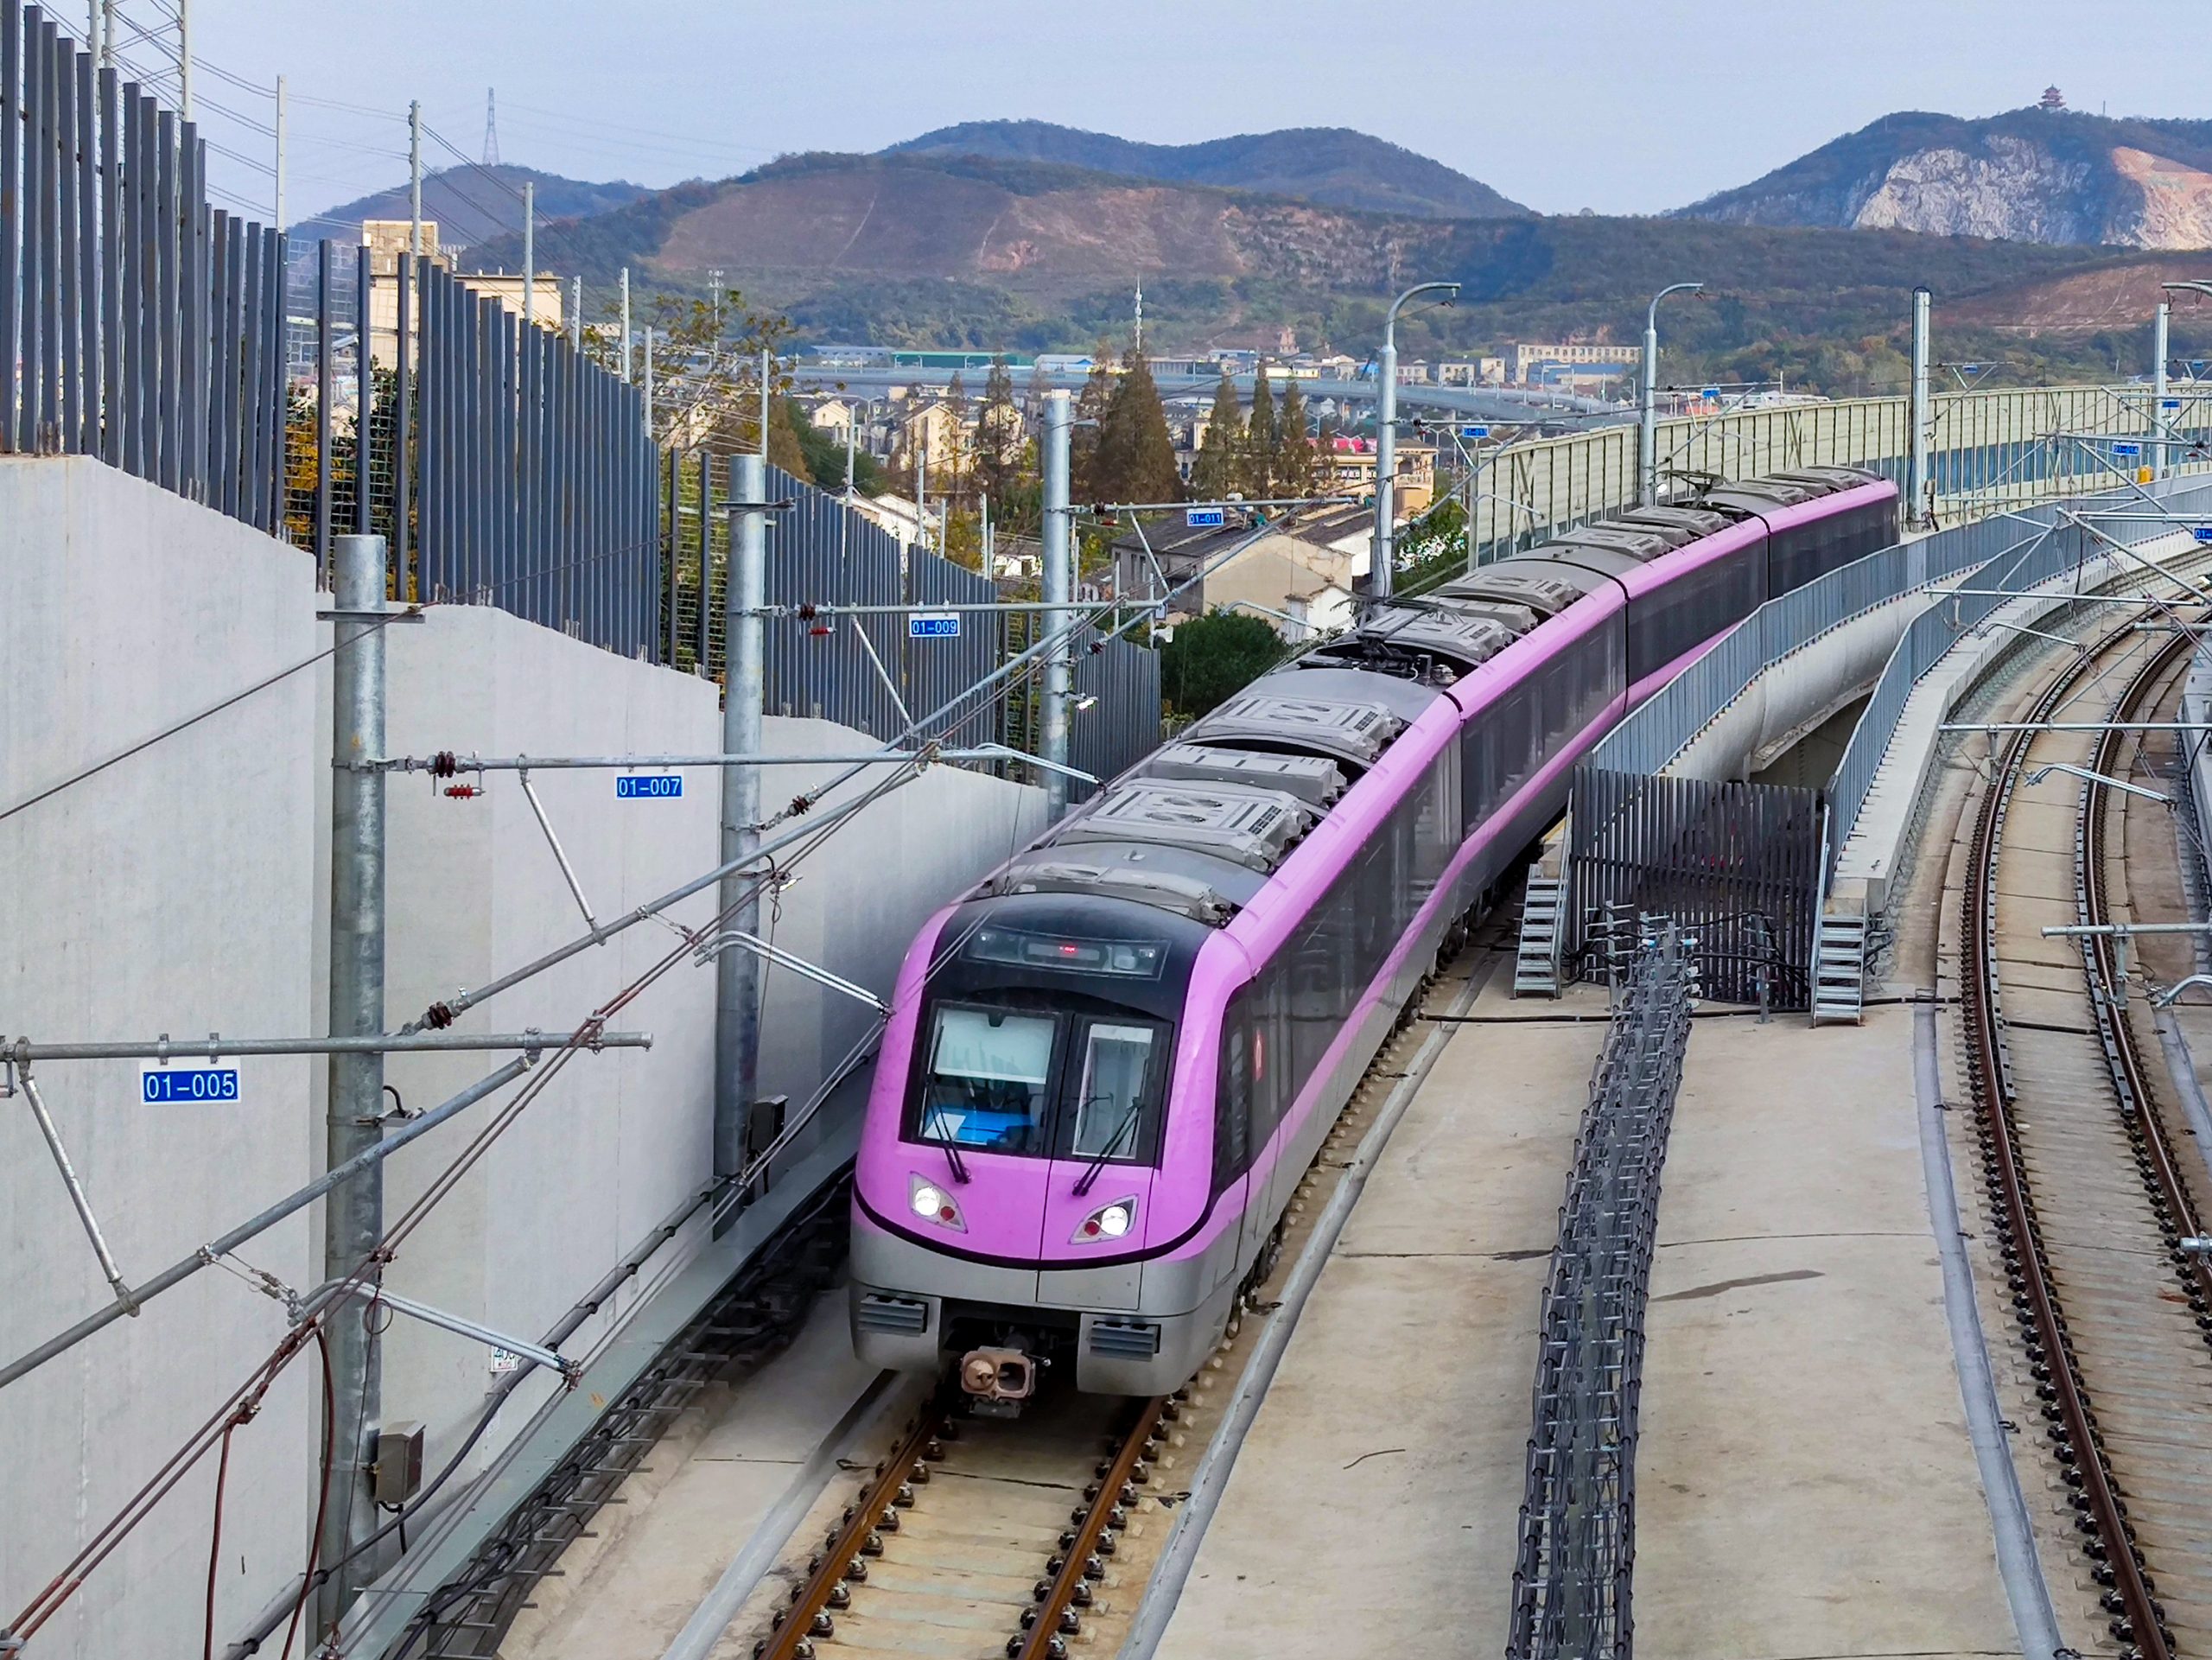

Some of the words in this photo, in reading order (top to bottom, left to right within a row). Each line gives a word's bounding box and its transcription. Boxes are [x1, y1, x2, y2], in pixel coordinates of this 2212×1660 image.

[1189, 514, 1221, 524] 01-011
[912, 620, 957, 633] 01-009
[619, 779, 680, 796] 01-007
[146, 1073, 235, 1099] 01-005
